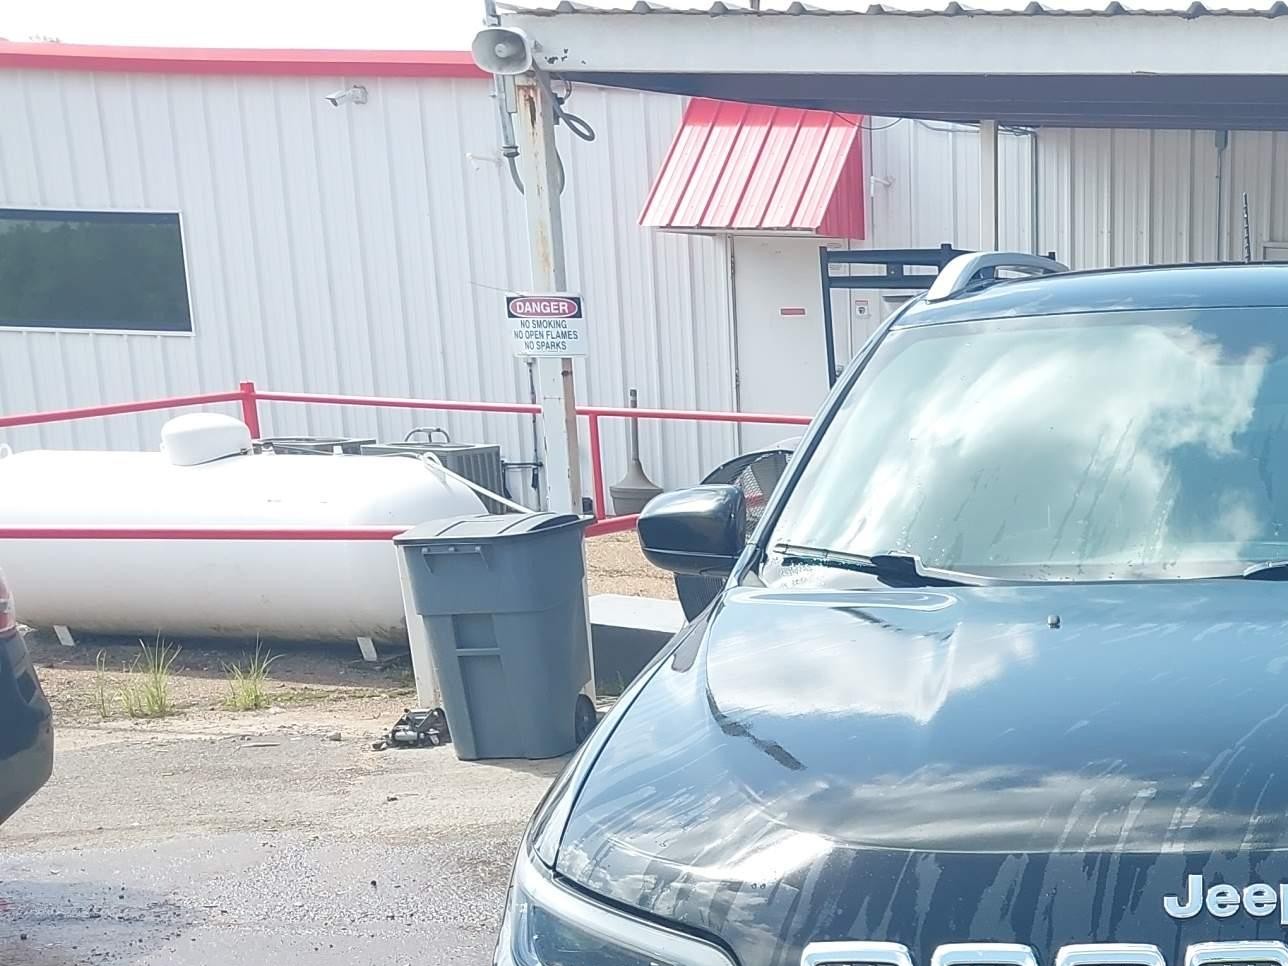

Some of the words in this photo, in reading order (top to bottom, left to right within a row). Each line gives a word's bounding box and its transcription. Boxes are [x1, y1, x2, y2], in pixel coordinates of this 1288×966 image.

[516, 302, 569, 313] DANGER
[520, 320, 531, 329] NO
[532, 320, 567, 329] SMOKING
[514, 330, 523, 339] NO
[525, 330, 544, 339] OPEN
[546, 330, 578, 339] FLAMES
[525, 341, 534, 350] NO
[536, 341, 567, 350] SPARKS
